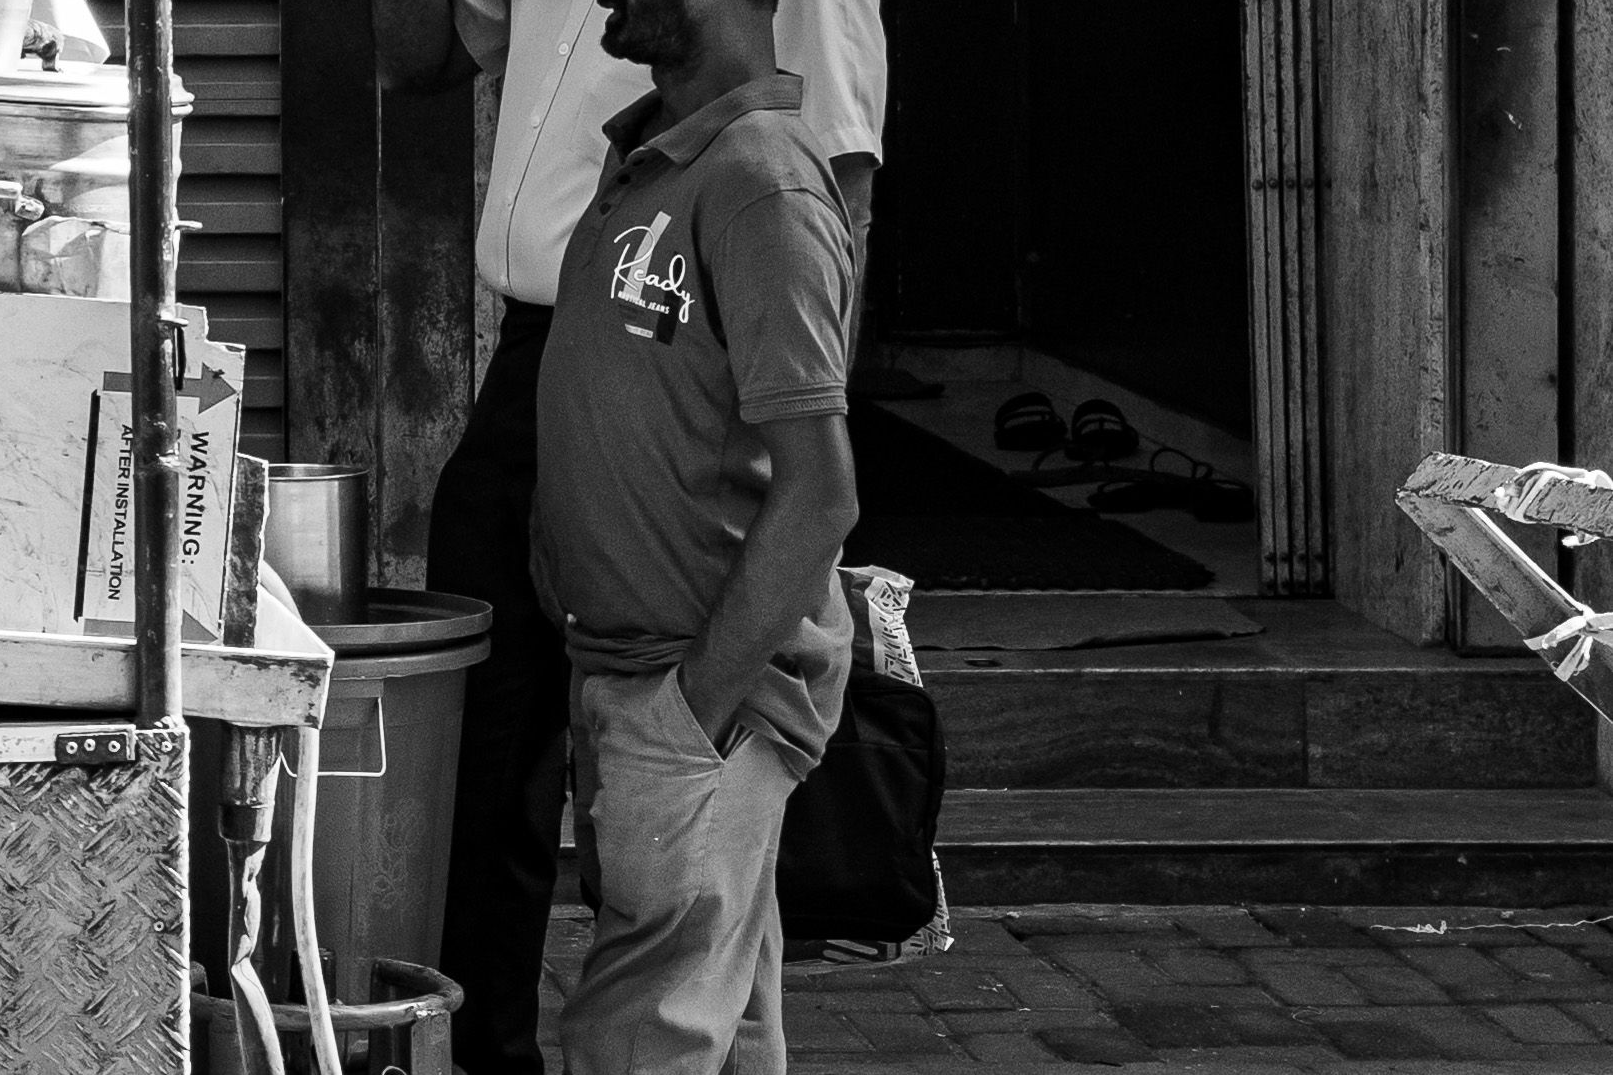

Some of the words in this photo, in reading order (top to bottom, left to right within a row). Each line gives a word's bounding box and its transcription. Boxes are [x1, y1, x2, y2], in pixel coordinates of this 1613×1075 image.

[610, 225, 696, 324] Ready
[118, 424, 134, 479] AFTER
[181, 430, 209, 566] WARNING:
[108, 483, 129, 601] INSTALLATION
